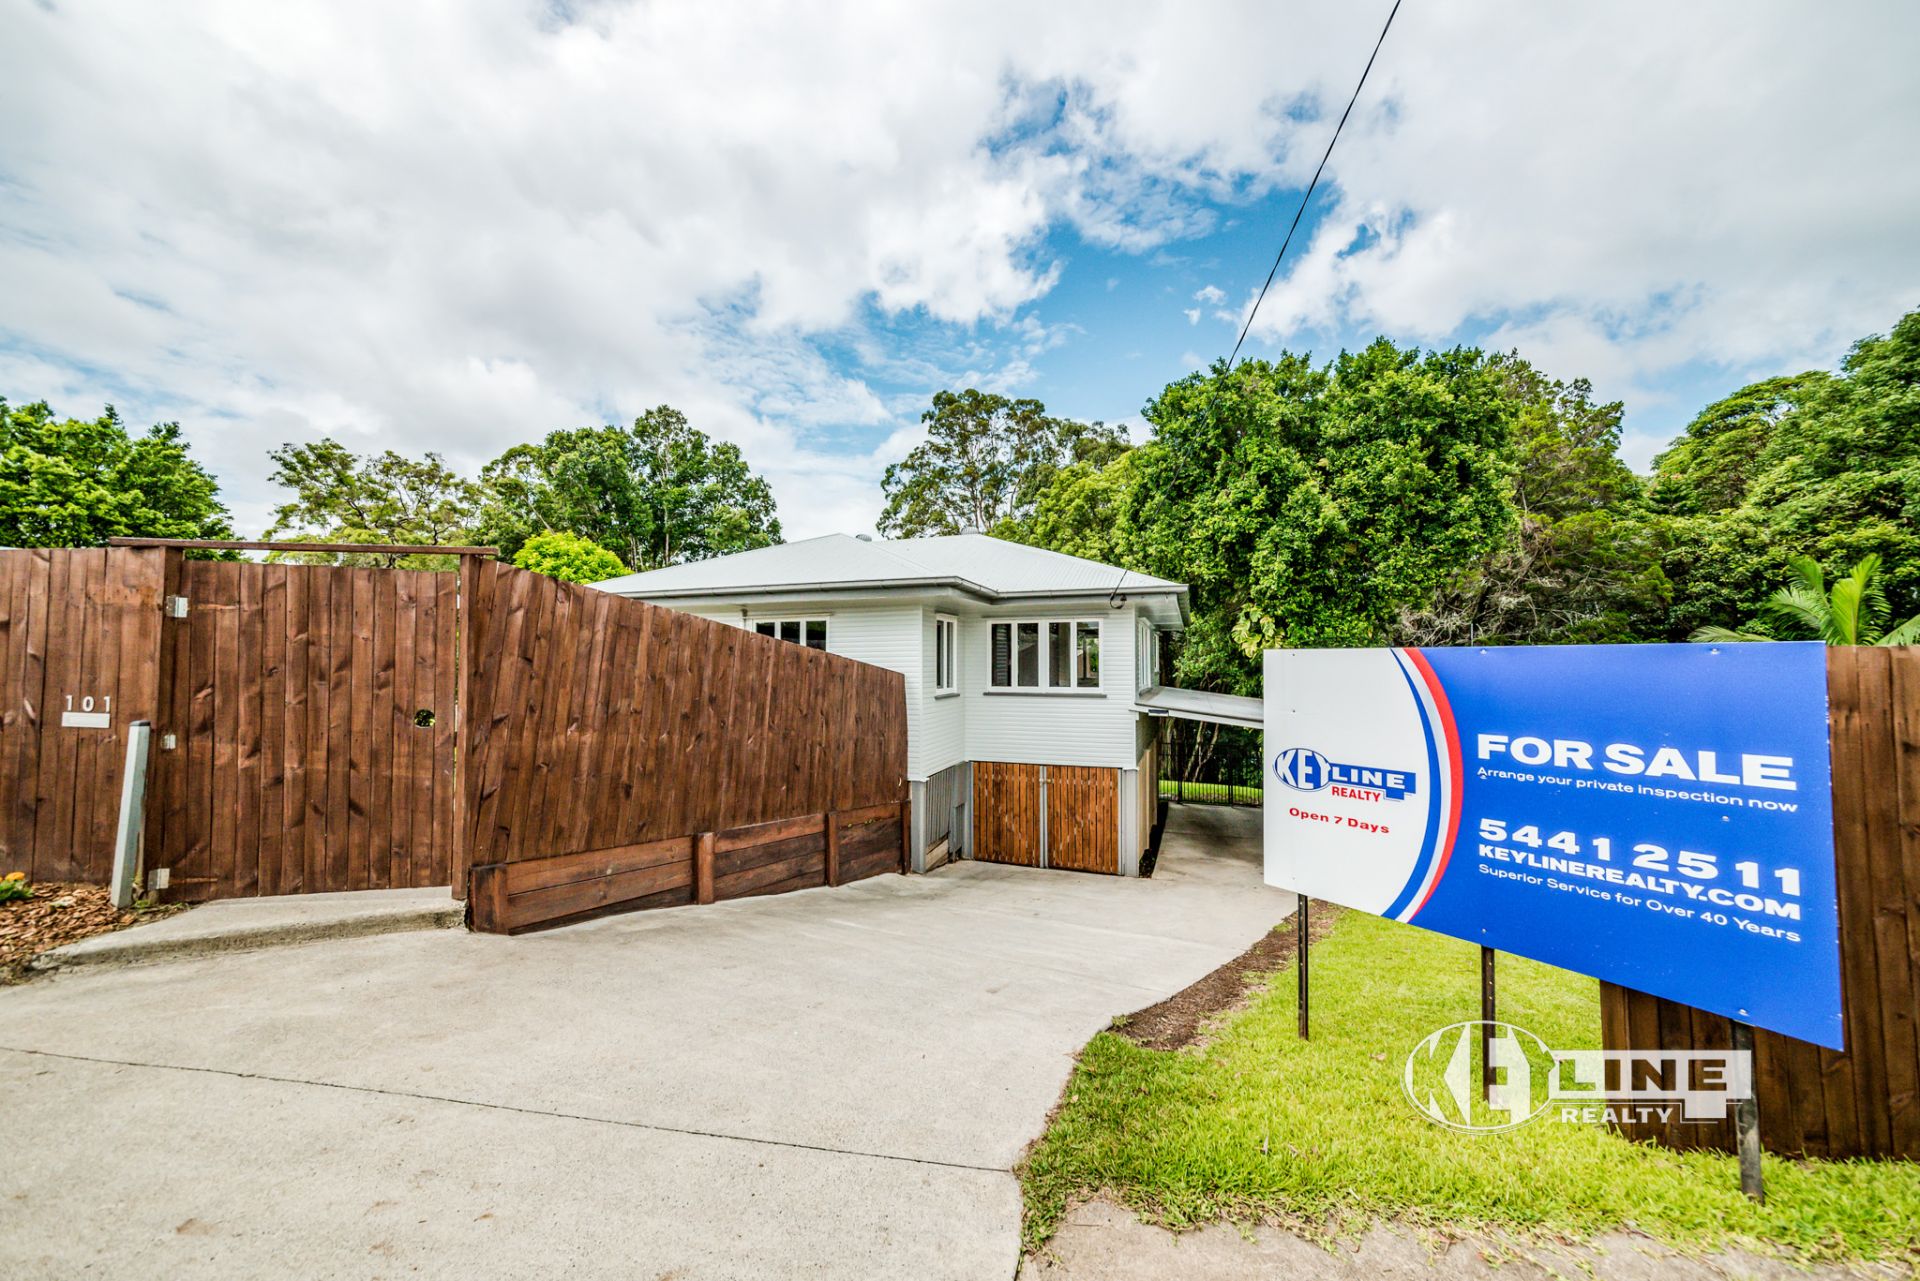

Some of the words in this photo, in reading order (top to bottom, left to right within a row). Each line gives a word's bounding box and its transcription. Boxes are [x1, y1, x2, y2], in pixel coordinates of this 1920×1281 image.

[65, 694, 111, 713] 101
[1477, 733, 1594, 770] FOR
[1602, 743, 1798, 791] SALE
[1331, 786, 1381, 803] REALTY
[1476, 766, 1535, 782] Arrange
[1538, 774, 1573, 786] your
[1575, 779, 1634, 794] private
[1638, 784, 1743, 807] inspection
[1748, 799, 1798, 813] now
[1288, 807, 1329, 823] Open
[1333, 815, 1343, 825] 7
[1347, 817, 1390, 834] Days
[1478, 817, 1611, 861] 5441
[1632, 843, 1801, 897] 2511
[1478, 843, 1801, 921] KEYLINEREALTY.COM
[1478, 863, 1543, 886] Superior
[1546, 877, 1612, 901] Service
[1614, 892, 1642, 907] for
[1646, 899, 1696, 919] Over
[1700, 911, 1728, 926] 40
[1732, 916, 1801, 943] Years
